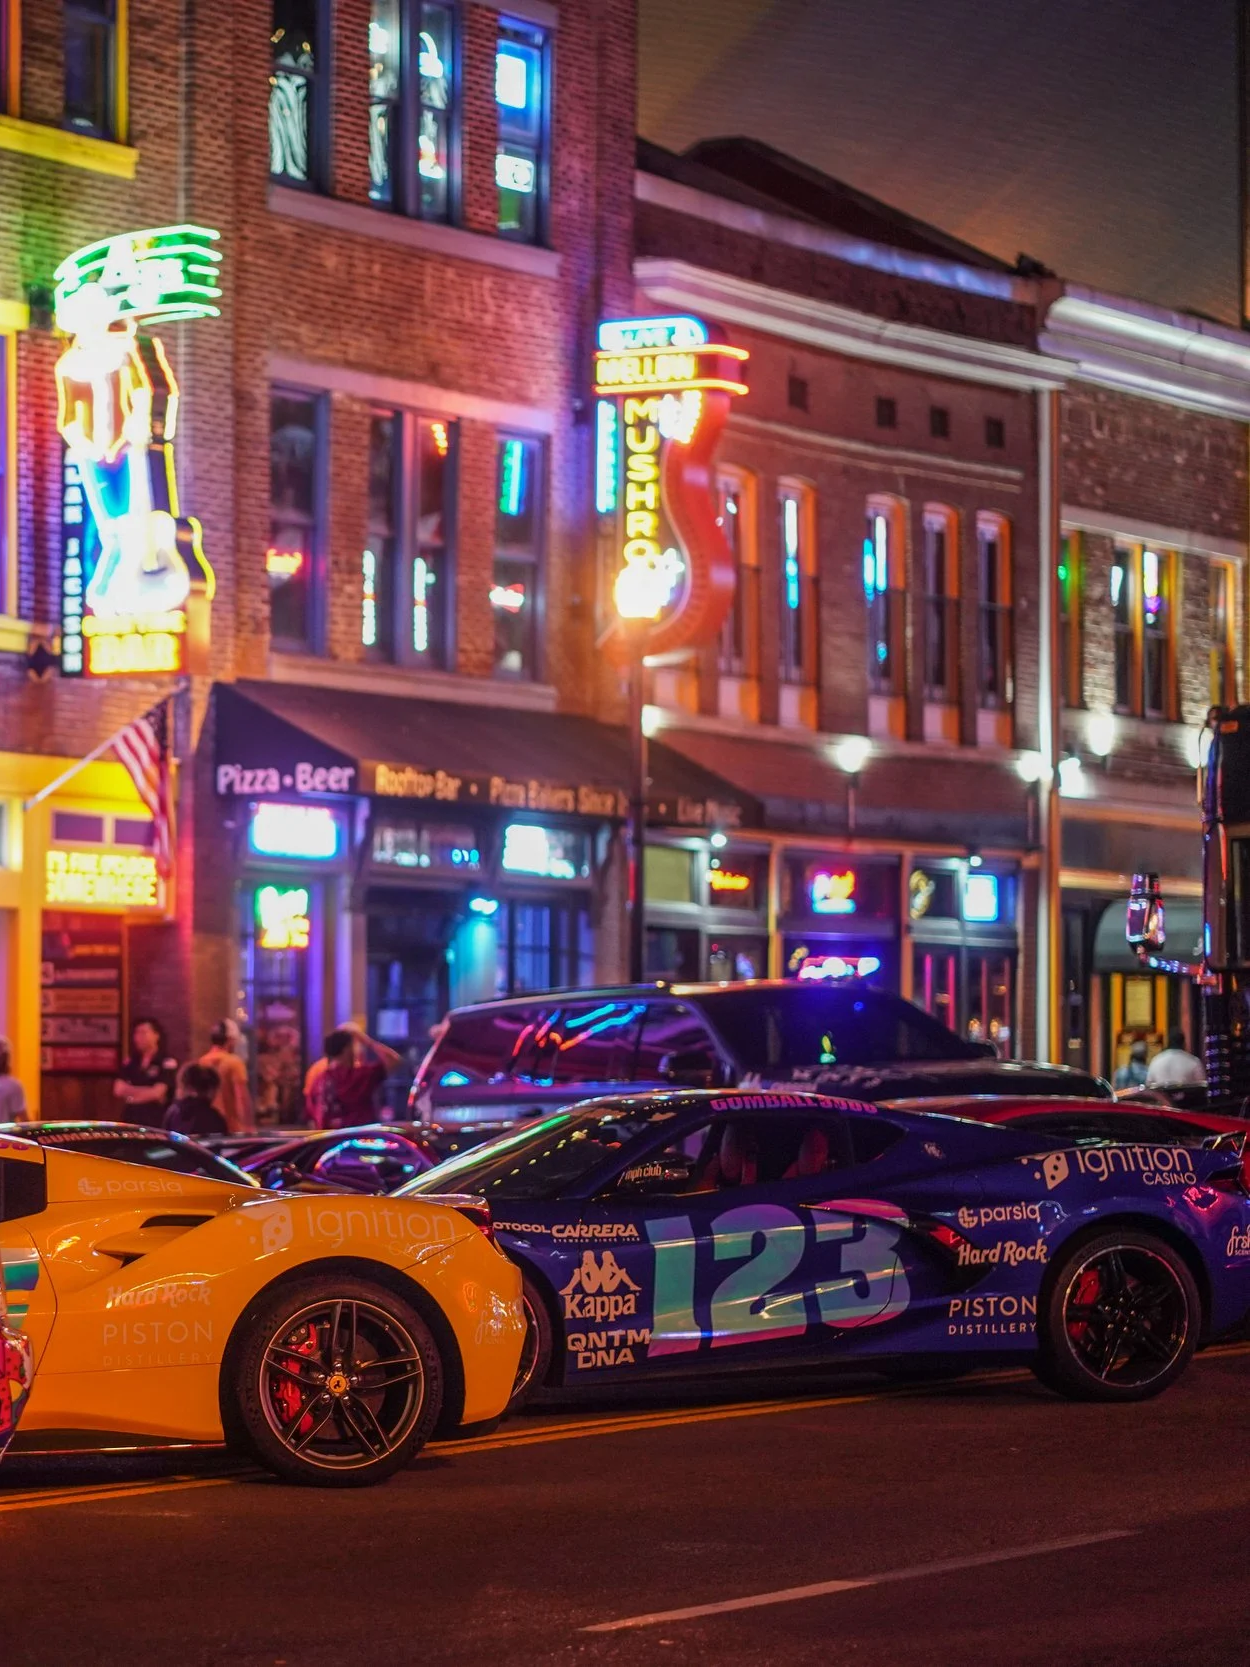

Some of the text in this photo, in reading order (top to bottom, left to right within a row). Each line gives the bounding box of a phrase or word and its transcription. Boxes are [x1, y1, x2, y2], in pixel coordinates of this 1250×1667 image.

[217, 762, 355, 794] Pizza Beer
[710, 1094, 818, 1111] GUMBALL
[643, 1164, 662, 1177] club
[1075, 1145, 1193, 1181] Ignition
[106, 1178, 182, 1196] parsiq
[1142, 1171, 1197, 1186] CASINO
[980, 1201, 1041, 1227] parsiq
[307, 1205, 456, 1248] Ignition
[551, 1223, 639, 1238] CARRERA
[957, 1238, 1048, 1266] Hard Rock
[644, 1198, 911, 1358] 123
[106, 1282, 212, 1309] Hard Rock
[948, 1295, 1038, 1318] PISTON
[564, 1293, 637, 1323] Kappa
[103, 1320, 214, 1346] PISTON
[567, 1328, 651, 1352] QNTM
[948, 1322, 1038, 1336] DISTILLERY
[103, 1352, 212, 1367] DISTILLERY
[577, 1348, 636, 1369] DNA
